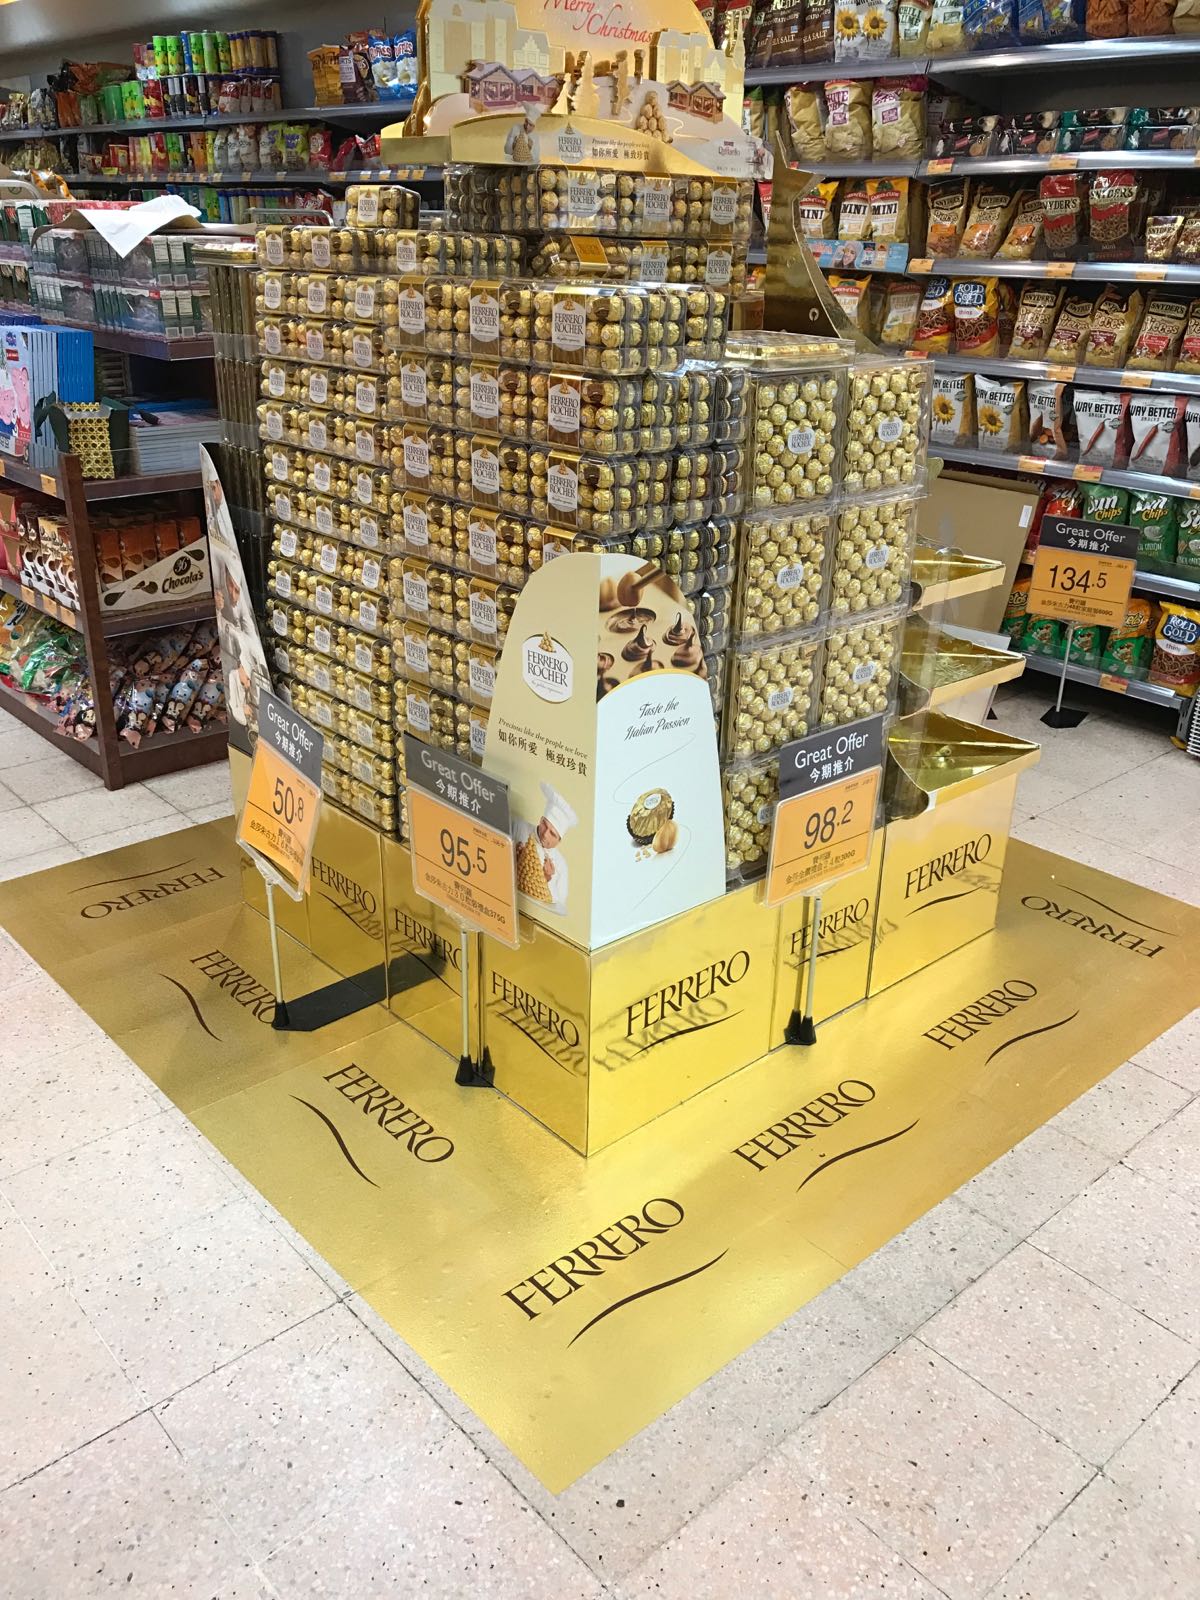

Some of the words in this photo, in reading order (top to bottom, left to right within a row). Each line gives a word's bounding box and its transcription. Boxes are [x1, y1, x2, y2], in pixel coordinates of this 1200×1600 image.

[587, 5, 653, 42] Christmas
[558, 136, 582, 146] FERRERO
[559, 144, 582, 153] ROCHER
[872, 203, 897, 215] MINI
[958, 283, 985, 294] ROLD
[400, 301, 423, 311] FERRERO
[954, 292, 984, 305] GOLD
[400, 309, 423, 319] ROCHER
[472, 305, 497, 317] FERRERO
[1151, 303, 1186, 314] SNYDER'S
[472, 315, 497, 327] ROCHER
[554, 313, 584, 325] FERRERO
[554, 322, 583, 335] ROCHER
[402, 374, 425, 386] FERRERO
[403, 382, 424, 394] ROCHER
[472, 382, 497, 394] FERRERO
[473, 392, 497, 404] ROCHER
[550, 395, 578, 408] FERRERO
[989, 391, 1015, 403] BETTER
[1037, 396, 1056, 408] BETTER
[550, 405, 578, 418] ROCHER
[1075, 401, 1093, 413] WAY
[1094, 403, 1122, 415] BETTER
[1130, 405, 1148, 417] WAY
[1148, 407, 1178, 419] BETTER
[405, 446, 428, 457] FERRERO
[406, 454, 427, 465] ROCHER
[473, 459, 498, 472] FERRERO
[473, 468, 497, 480] ROCHER
[550, 475, 576, 488] FERRERO
[550, 484, 576, 498] ROCHER
[1087, 495, 1118, 514] Sun
[1132, 496, 1168, 514] Sun
[405, 513, 427, 526] FERRERO
[1095, 508, 1123, 521] Chips
[1142, 508, 1169, 522] Chips
[405, 522, 427, 535] ROCHER
[1055, 522, 1090, 538] Great
[1093, 527, 1127, 544] Offer
[471, 531, 495, 544] FERRERO
[1067, 537, 1110, 553] 今期推介
[471, 540, 494, 553] ROCHER
[162, 570, 204, 594] Chocola's
[1049, 564, 1107, 594] 134.5
[471, 600, 495, 614] FERRERO
[472, 609, 495, 623] ROCHER
[1169, 616, 1197, 632] ROLD
[1163, 625, 1196, 643] GOLD
[528, 650, 568, 673] FERRERO
[471, 664, 495, 679] FERRERO
[528, 662, 567, 687] ROCHER
[471, 673, 494, 687] ROCHER
[639, 702, 663, 719] Taste
[664, 696, 680, 713] the
[267, 703, 290, 735] Great
[291, 723, 314, 753] Offer
[624, 722, 654, 741] Italian
[655, 717, 690, 734] Passion
[499, 717, 522, 733] Precious
[524, 727, 534, 737] like
[535, 732, 545, 741] the
[545, 738, 564, 749] people
[564, 745, 574, 753] we
[574, 748, 588, 759] love
[274, 731, 303, 765] 今期推介
[498, 729, 538, 756] 如你所愛
[545, 748, 587, 776] 極致珍貴
[795, 745, 833, 769] Great
[836, 731, 869, 754] Offer
[421, 750, 457, 784] Great
[461, 771, 496, 804] Offer
[809, 756, 855, 784] 今期推介
[272, 777, 304, 825] 50.8
[436, 778, 482, 814] 今期推介
[804, 800, 854, 850] 98.2
[440, 828, 488, 876] 95.5
[904, 833, 992, 901] FERRERO
[80, 867, 227, 920] FERRERO
[311, 857, 376, 915] FERRERO
[789, 898, 869, 956] FERRERO
[1020, 895, 1166, 959] FERRERO
[394, 909, 469, 973] FERRERO
[189, 949, 278, 1026] FERRERO
[625, 950, 750, 1038] FERRERO
[491, 970, 580, 1048] FERRERO
[921, 979, 1038, 1051] FERRERO
[322, 1063, 455, 1163] FERRERO
[730, 1078, 877, 1172] FERRERO
[502, 1196, 686, 1320] FERRERO
